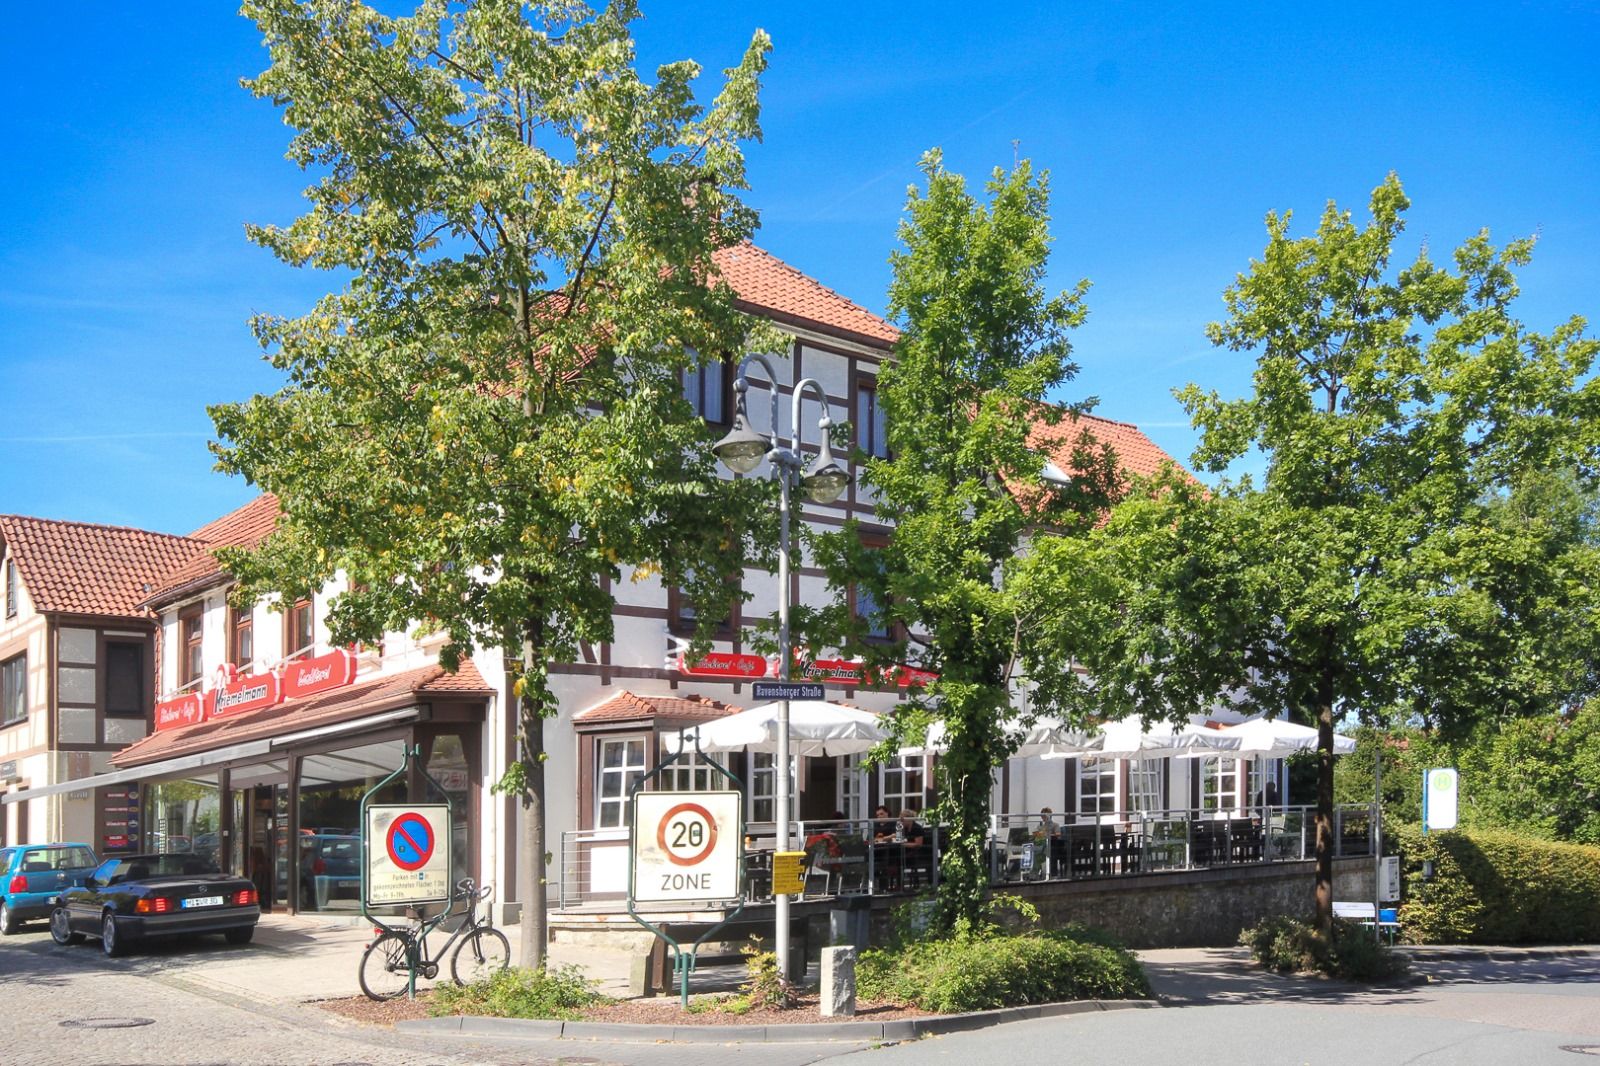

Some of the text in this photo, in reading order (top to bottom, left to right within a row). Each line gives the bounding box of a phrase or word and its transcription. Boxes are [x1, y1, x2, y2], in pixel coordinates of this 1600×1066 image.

[213, 684, 268, 715] Kriemelmann
[756, 685, 822, 699] Ravensberger Straße
[672, 821, 703, 848] 20
[392, 873, 409, 881] Parken
[661, 873, 712, 891] ZONE
